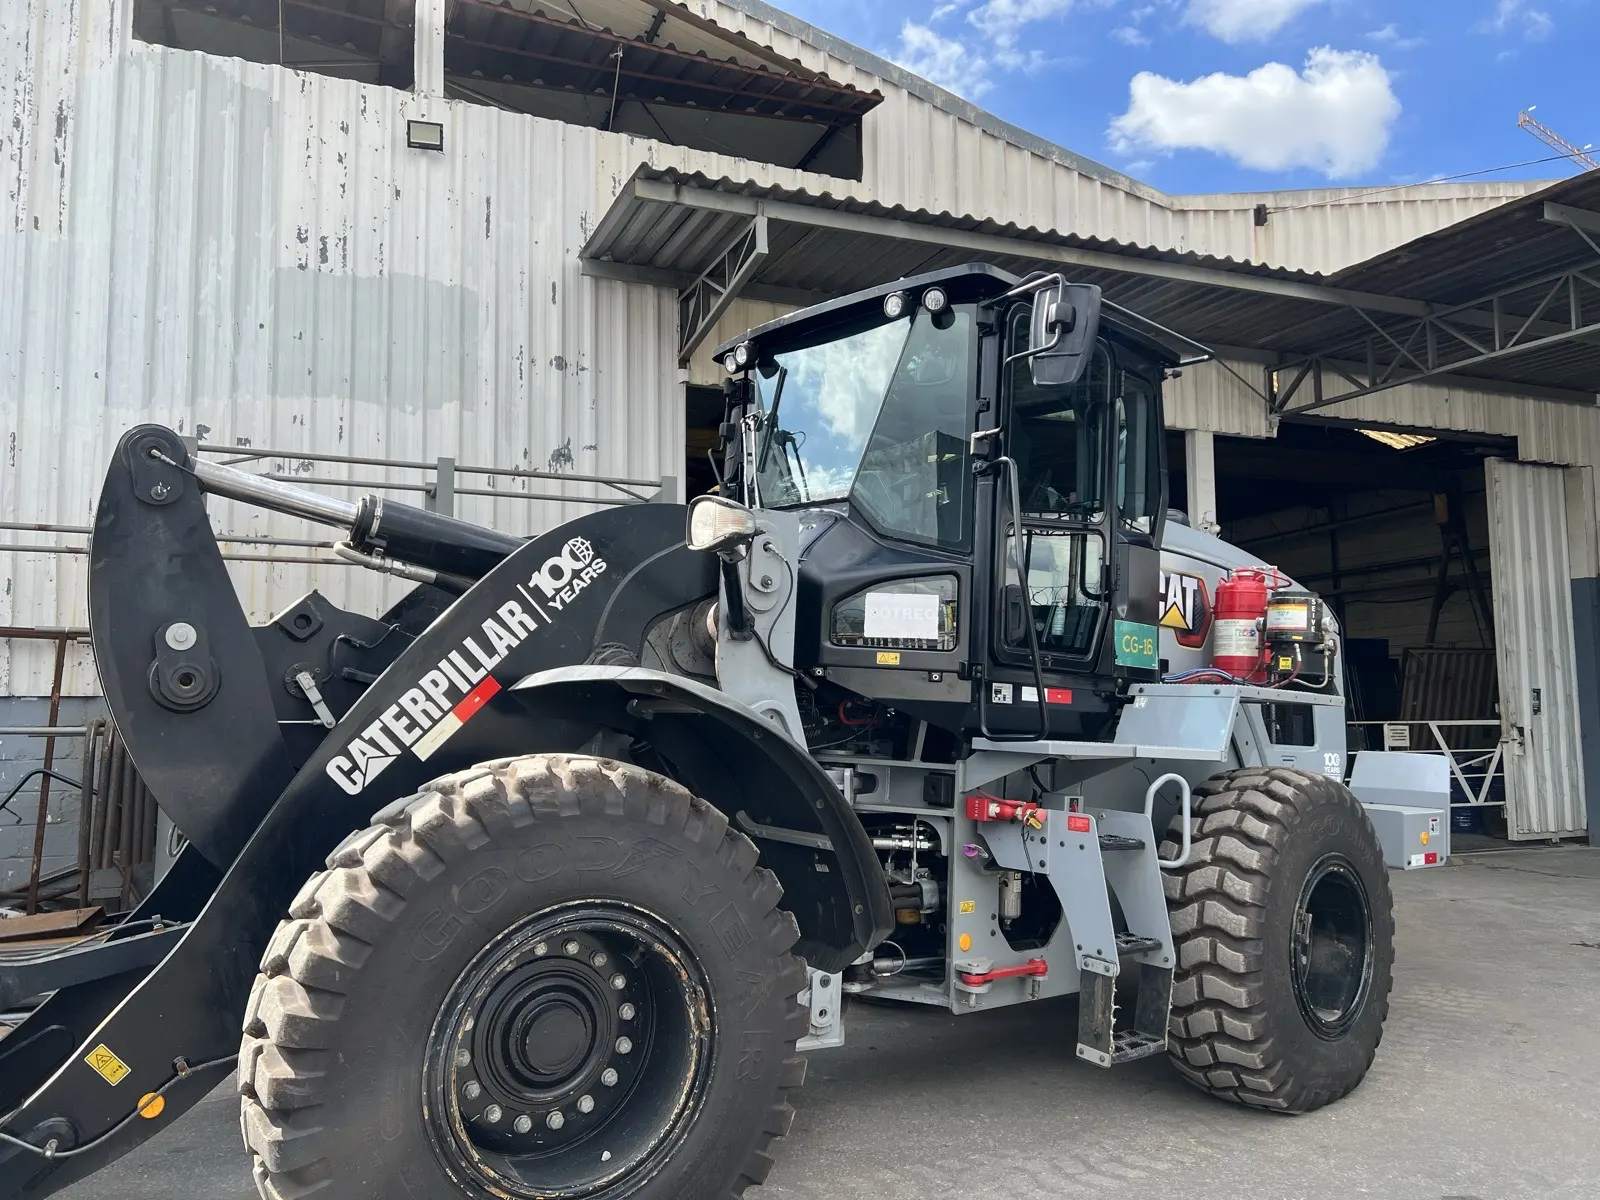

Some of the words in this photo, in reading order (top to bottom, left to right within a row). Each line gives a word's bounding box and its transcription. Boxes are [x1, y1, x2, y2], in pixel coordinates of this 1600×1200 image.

[547, 557, 607, 611] YEARS
[1122, 634, 1153, 656] CG-16
[325, 599, 538, 796] CATERPILLAR
